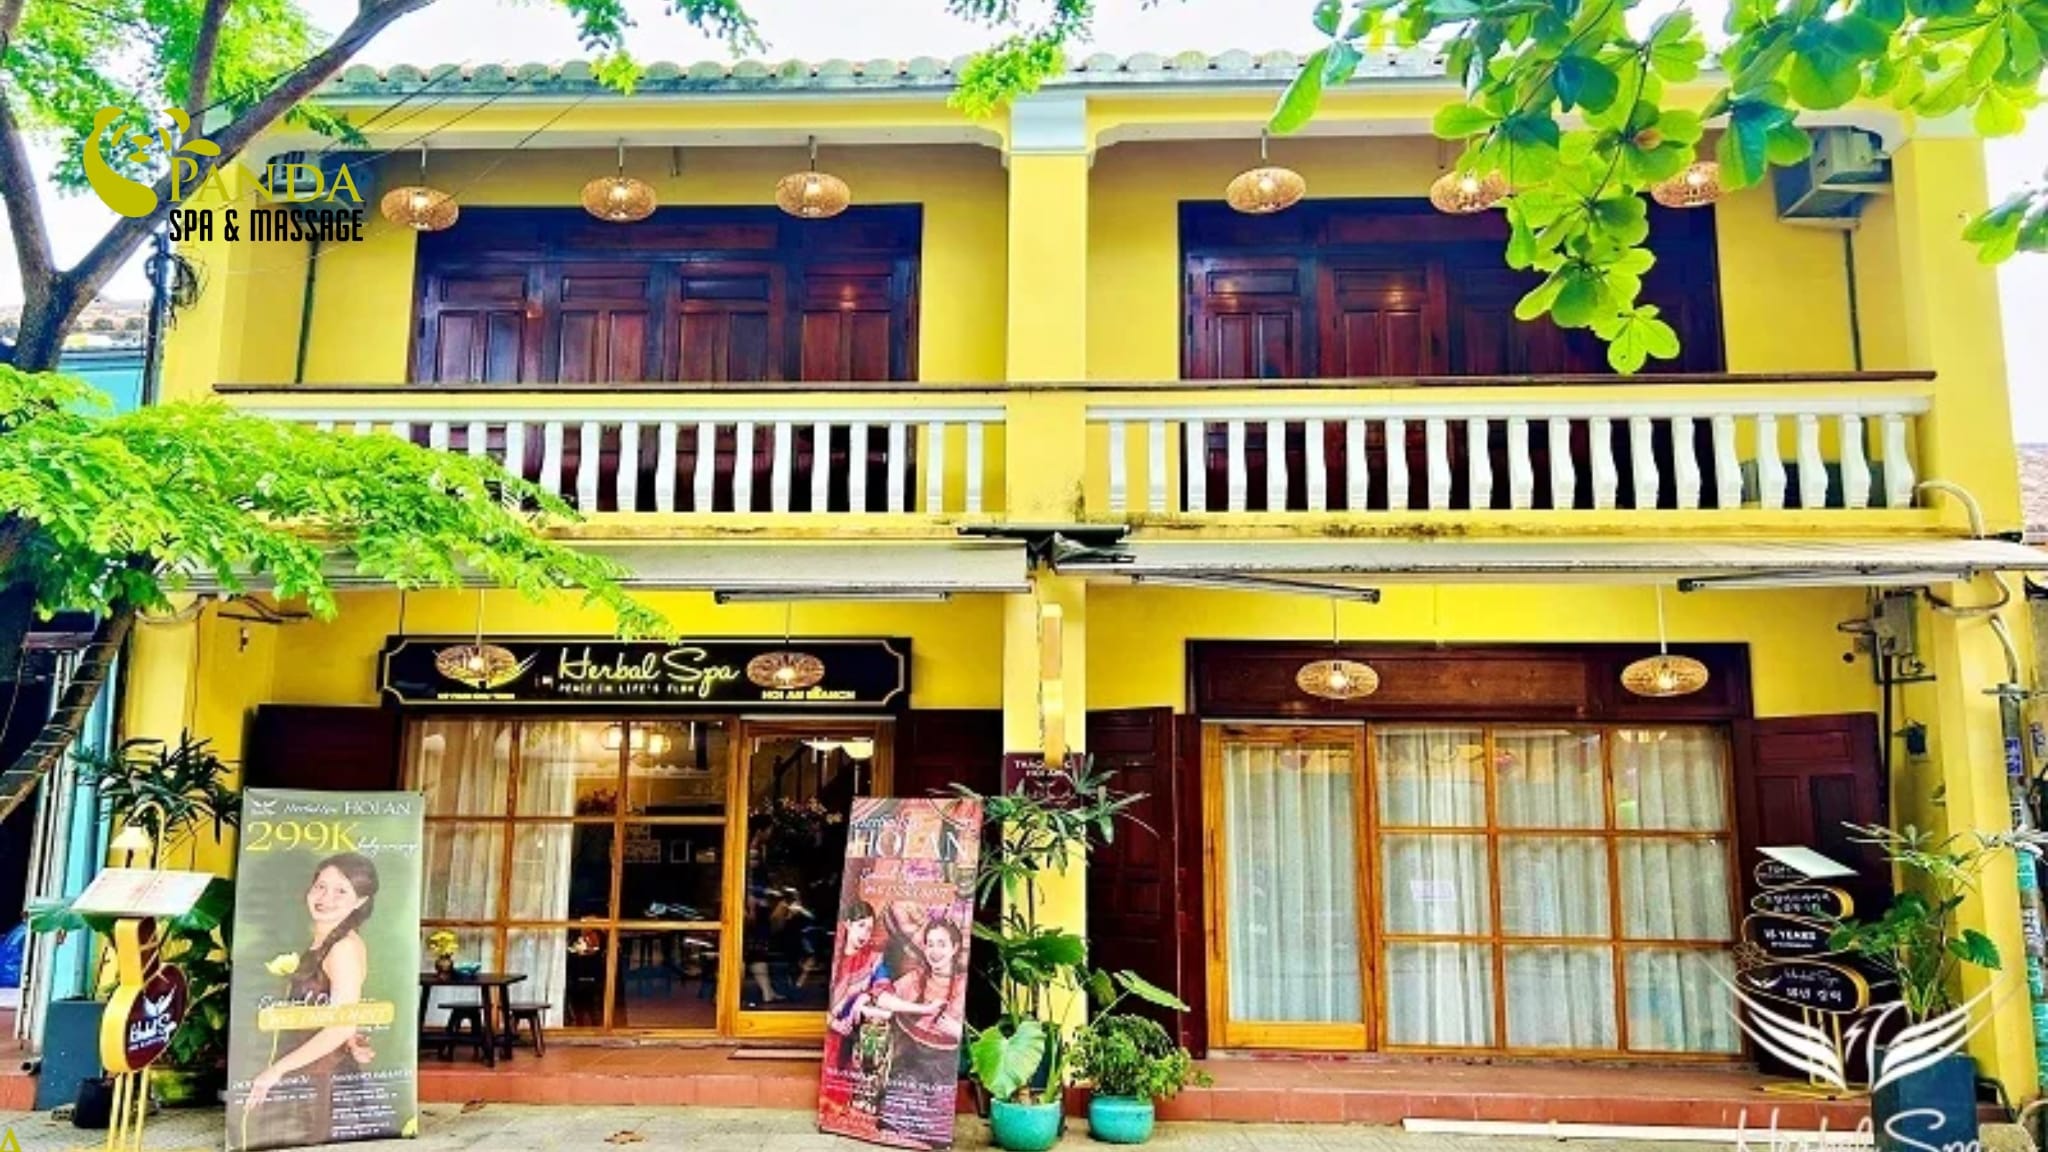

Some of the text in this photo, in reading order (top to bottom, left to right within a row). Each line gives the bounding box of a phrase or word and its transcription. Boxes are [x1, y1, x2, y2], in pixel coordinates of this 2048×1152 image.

[558, 646, 740, 698] Herbal Spa
[382, 801, 412, 816] AN
[245, 820, 361, 851] 299K
